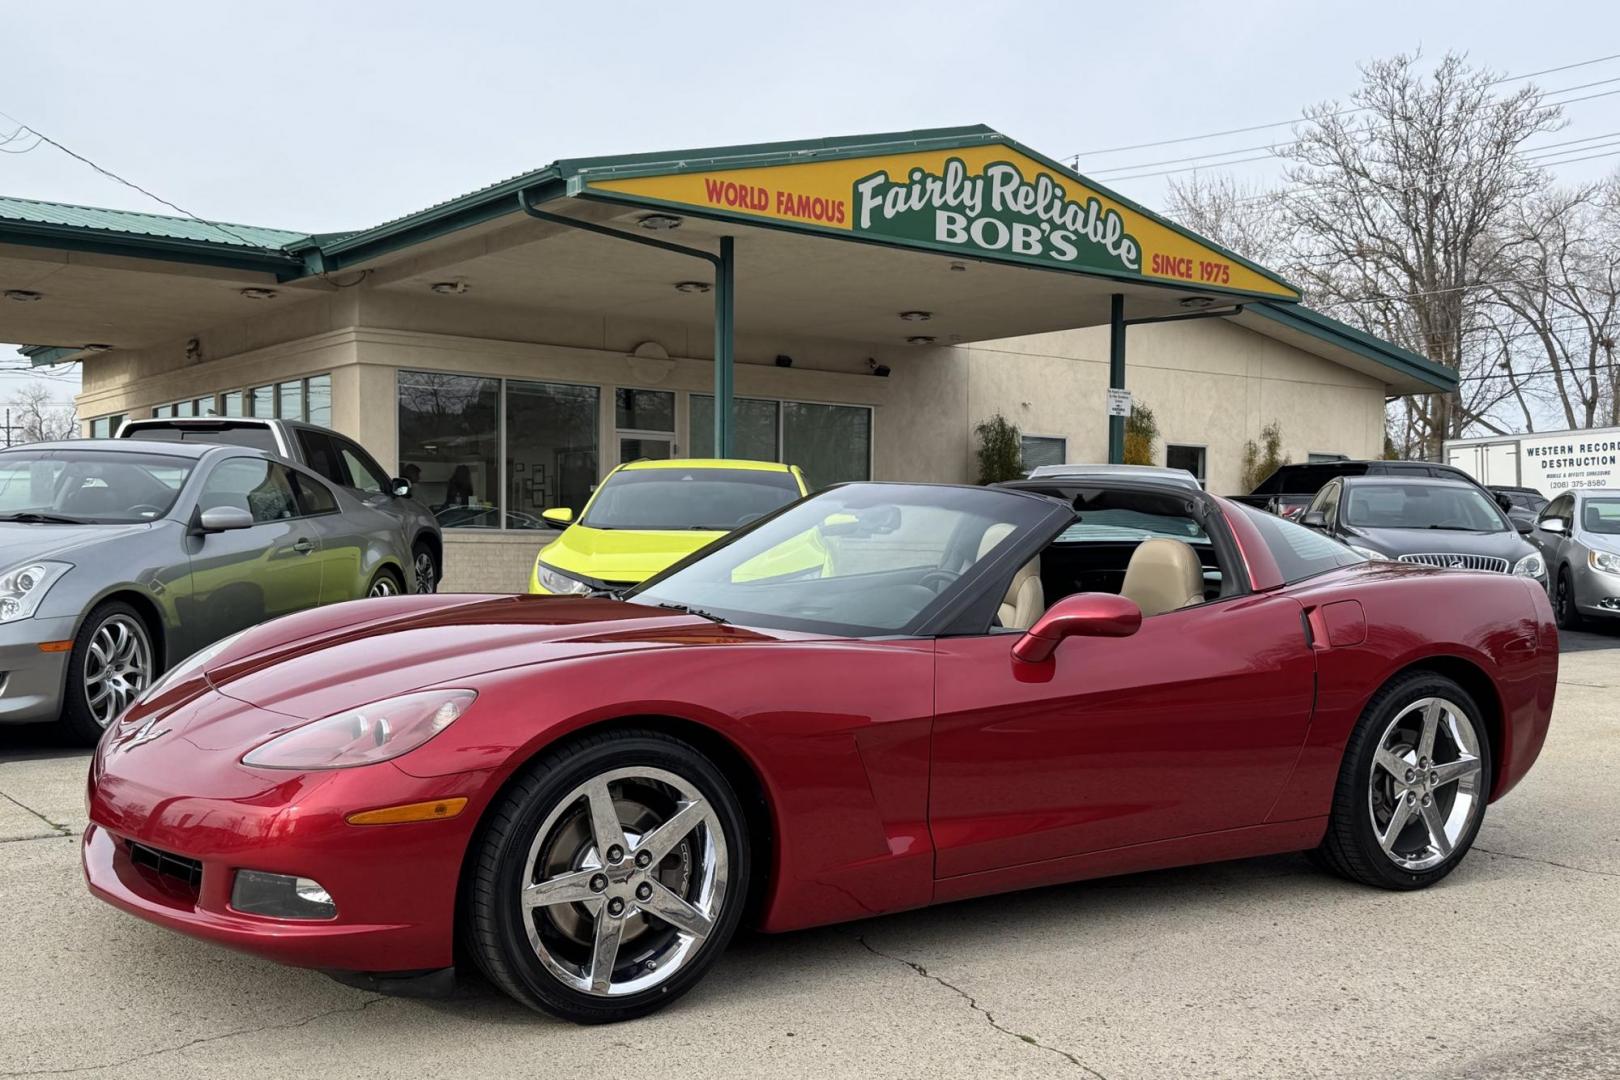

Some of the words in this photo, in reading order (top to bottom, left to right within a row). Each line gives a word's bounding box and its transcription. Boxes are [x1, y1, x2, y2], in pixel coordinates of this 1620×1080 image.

[704, 178, 769, 212] WORLD
[776, 191, 845, 224] FAMOUS
[858, 161, 984, 229] Fairly
[987, 164, 1139, 269] Reliable
[935, 209, 1078, 261] BOB'S
[1152, 253, 1193, 279] SINCE
[1199, 261, 1230, 284] 1975
[1527, 445, 1573, 457] WESTERN
[1542, 456, 1616, 469] DESTRUCTION
